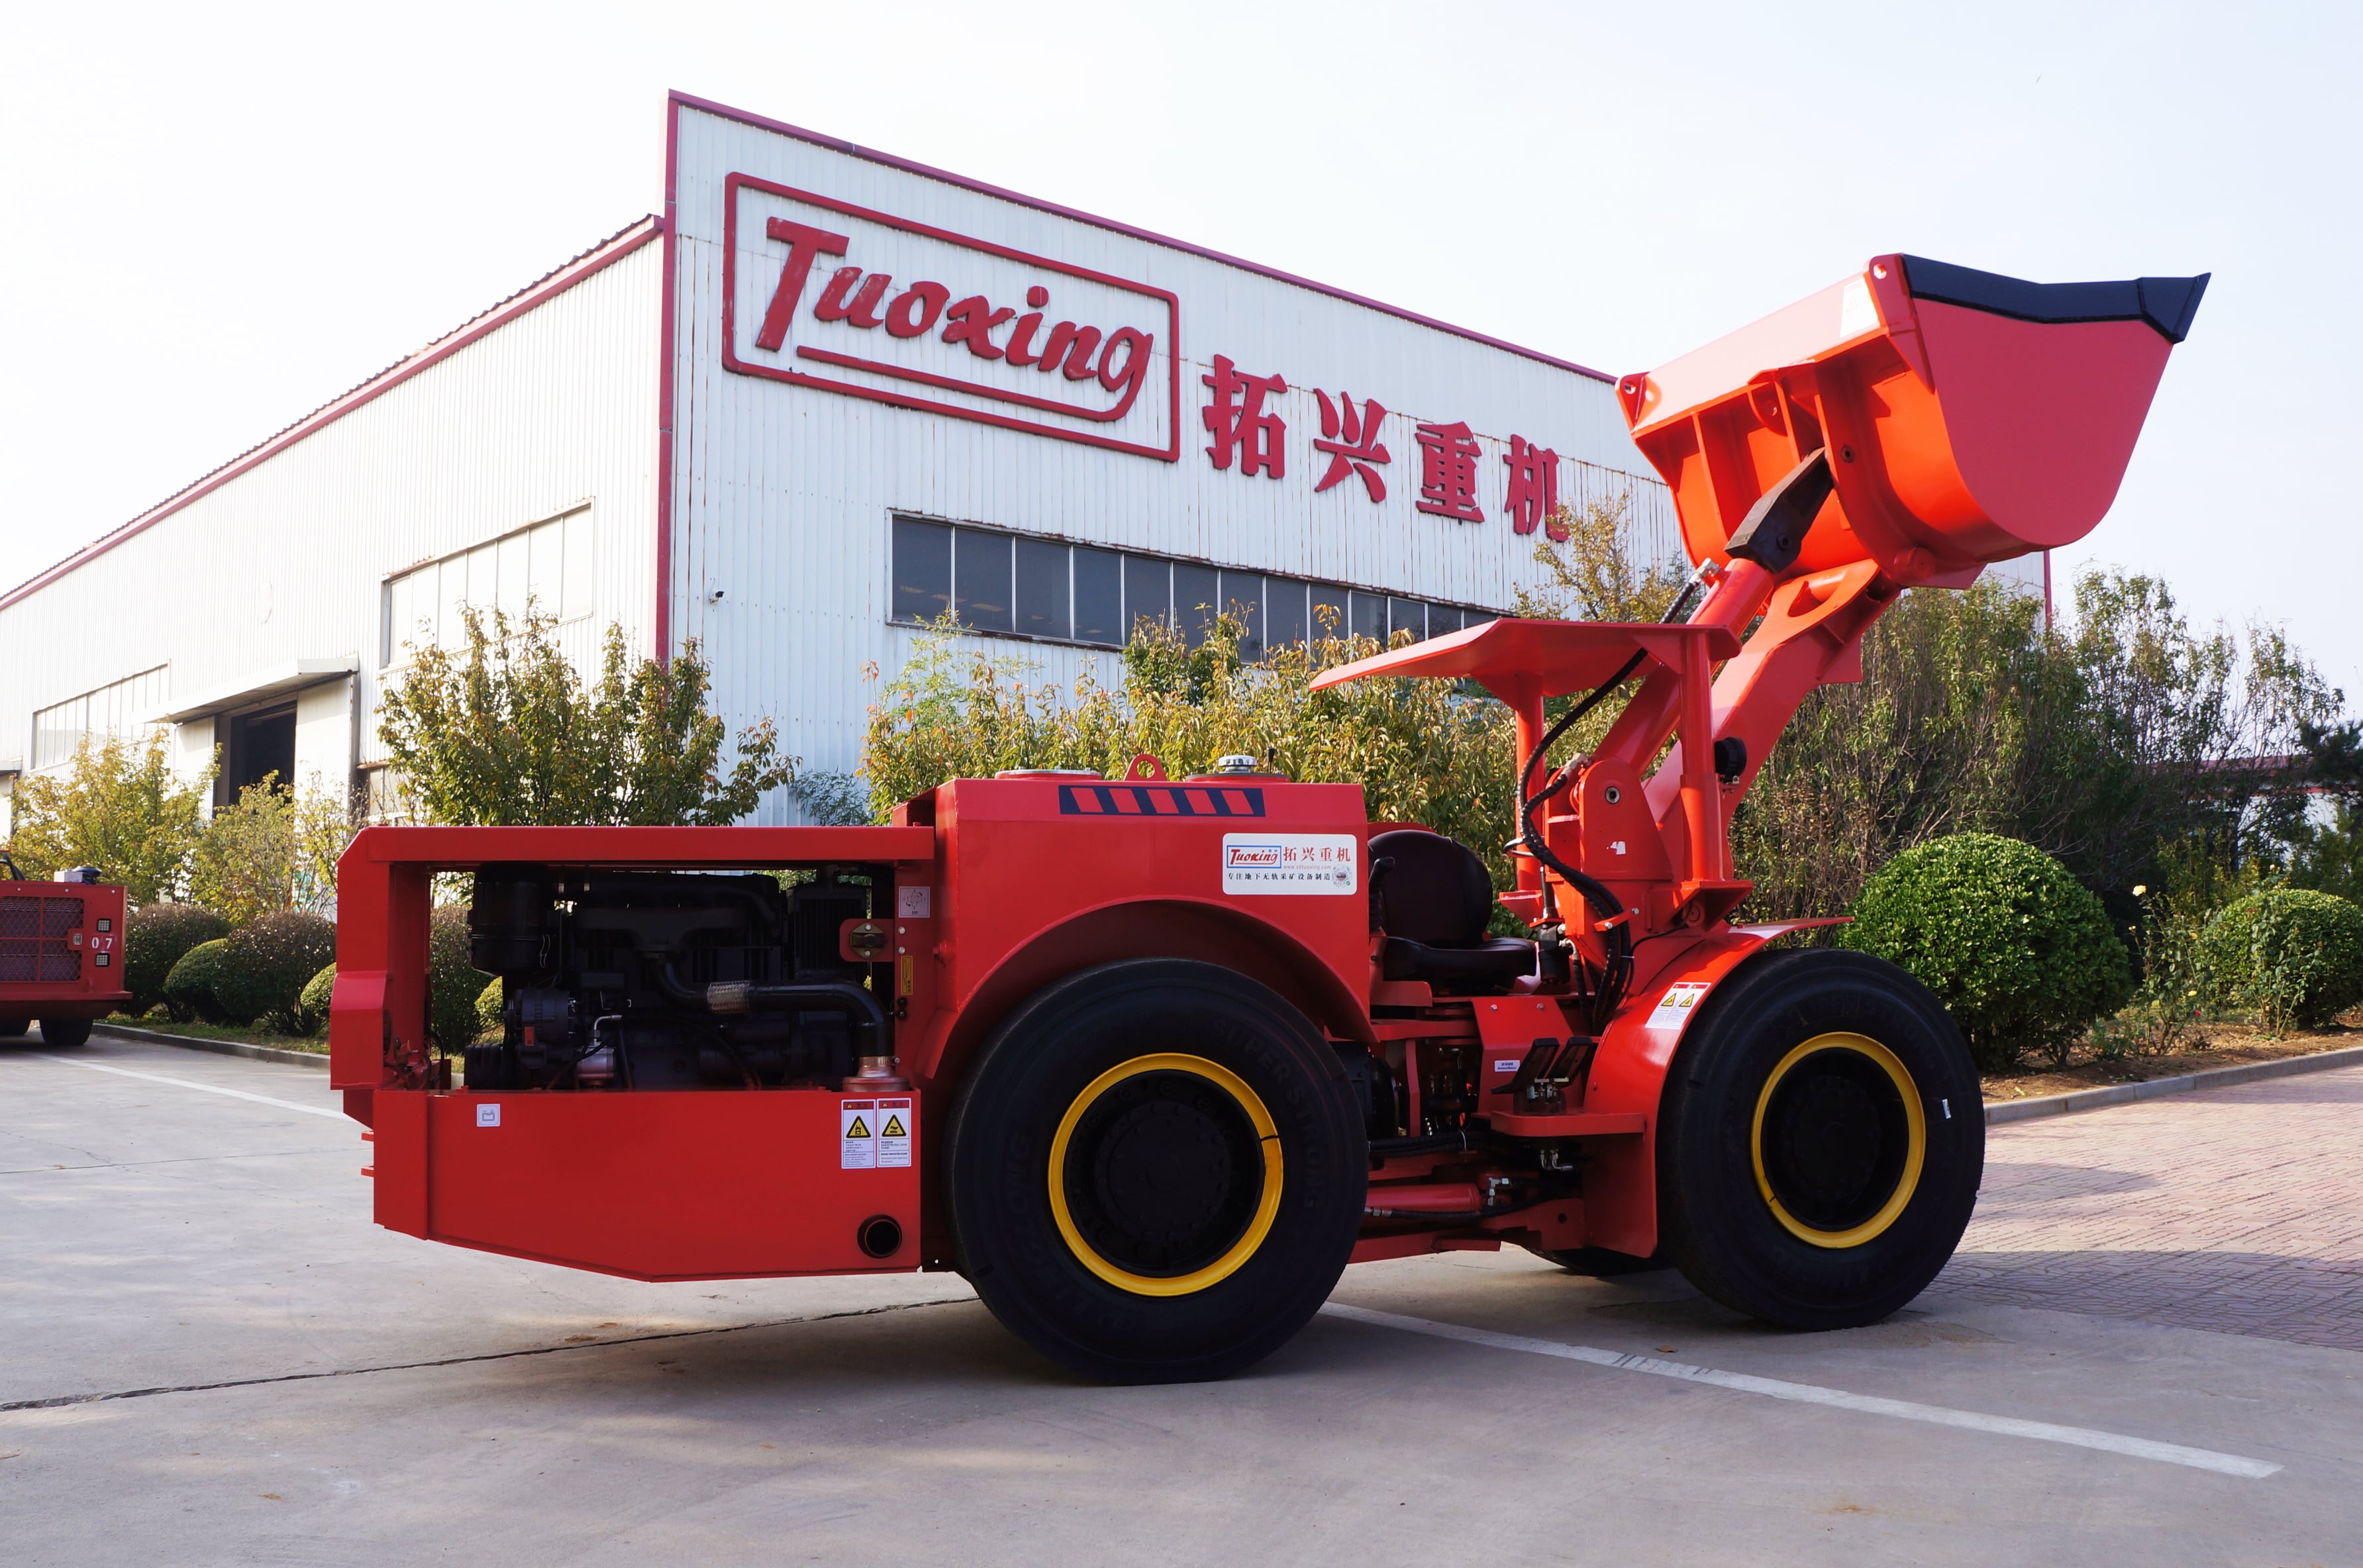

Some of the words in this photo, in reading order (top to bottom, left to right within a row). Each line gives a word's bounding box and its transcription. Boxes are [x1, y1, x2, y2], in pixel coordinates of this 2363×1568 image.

[755, 217, 1154, 422] Tuoxing
[1202, 354, 1570, 542] 拓兴重机
[1230, 849, 1278, 865] Tuoxing
[1283, 847, 1351, 862] 拓兴重机
[1228, 872, 1331, 881] 专注地下无轨采矿设备制造
[91, 936, 113, 950] 07
